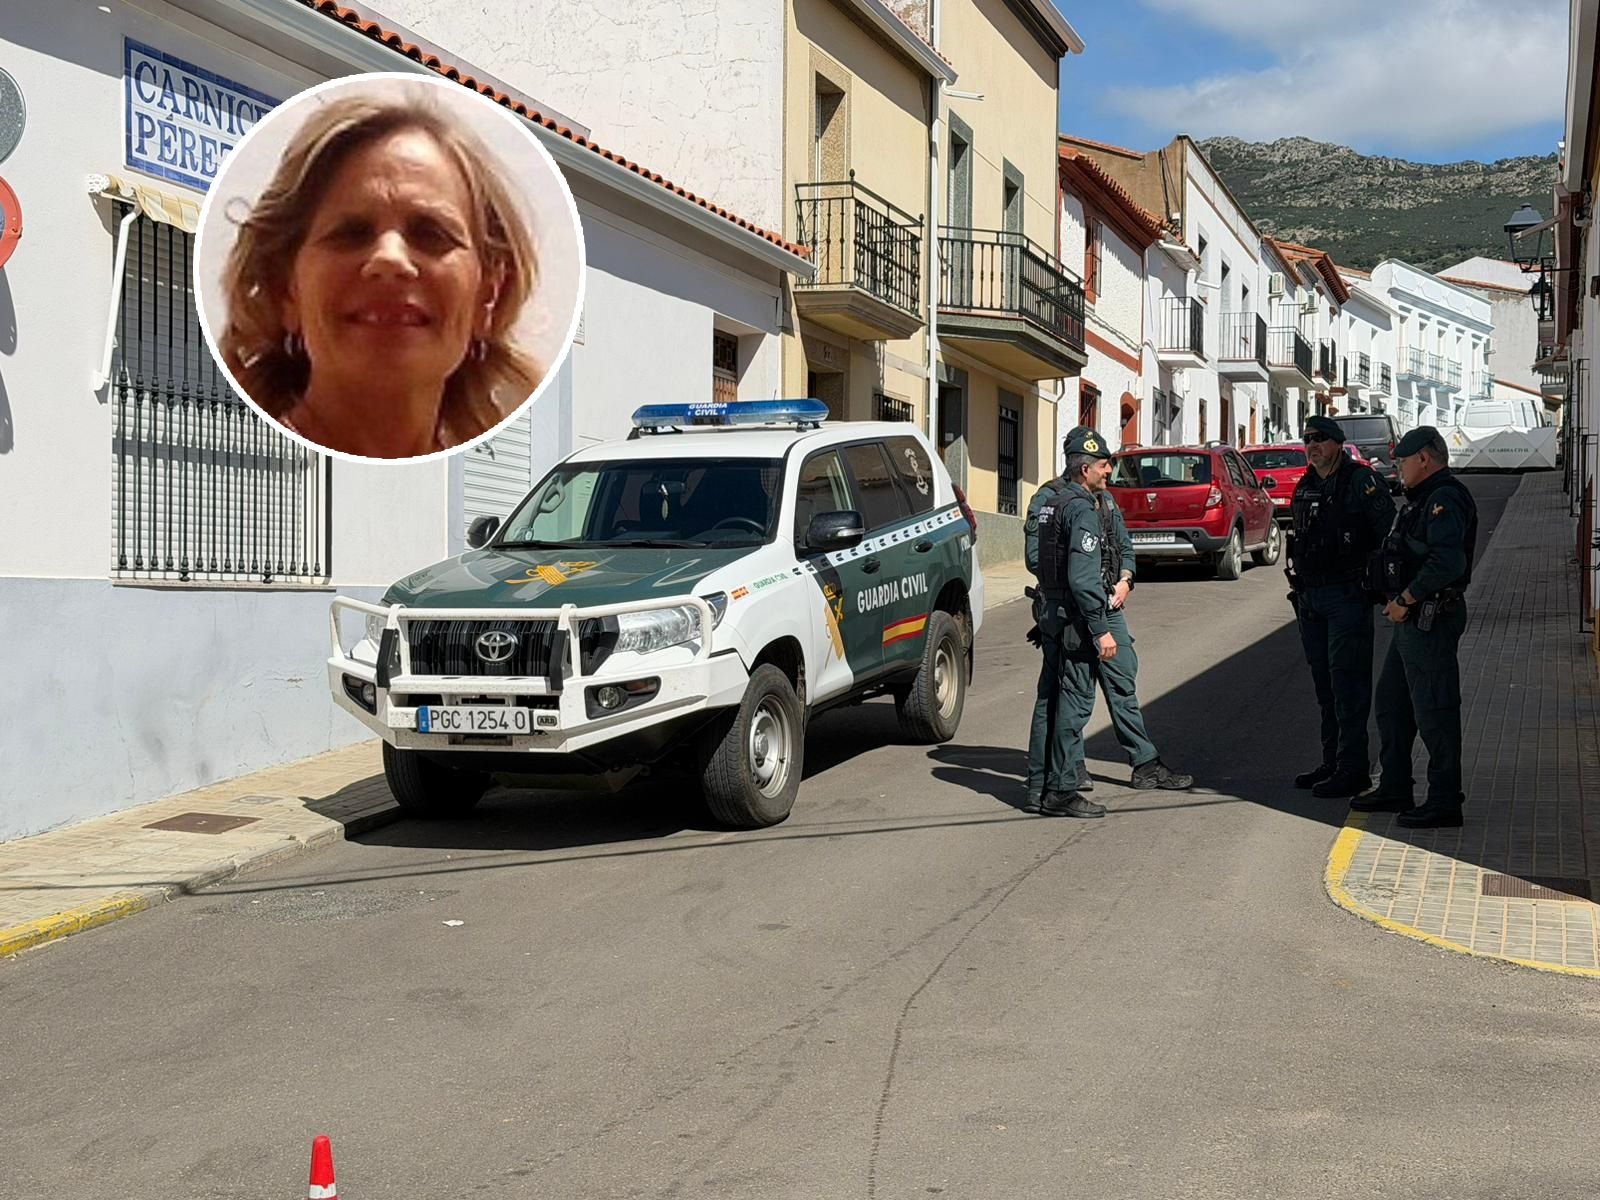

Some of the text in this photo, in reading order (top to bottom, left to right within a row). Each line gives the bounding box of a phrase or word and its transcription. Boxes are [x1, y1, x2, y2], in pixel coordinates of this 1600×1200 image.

[688, 402, 728, 410] GUARDIA
[857, 572, 928, 614] GUARDIA CIVIL
[430, 709, 461, 729] PGC
[468, 710, 509, 730] 1254
